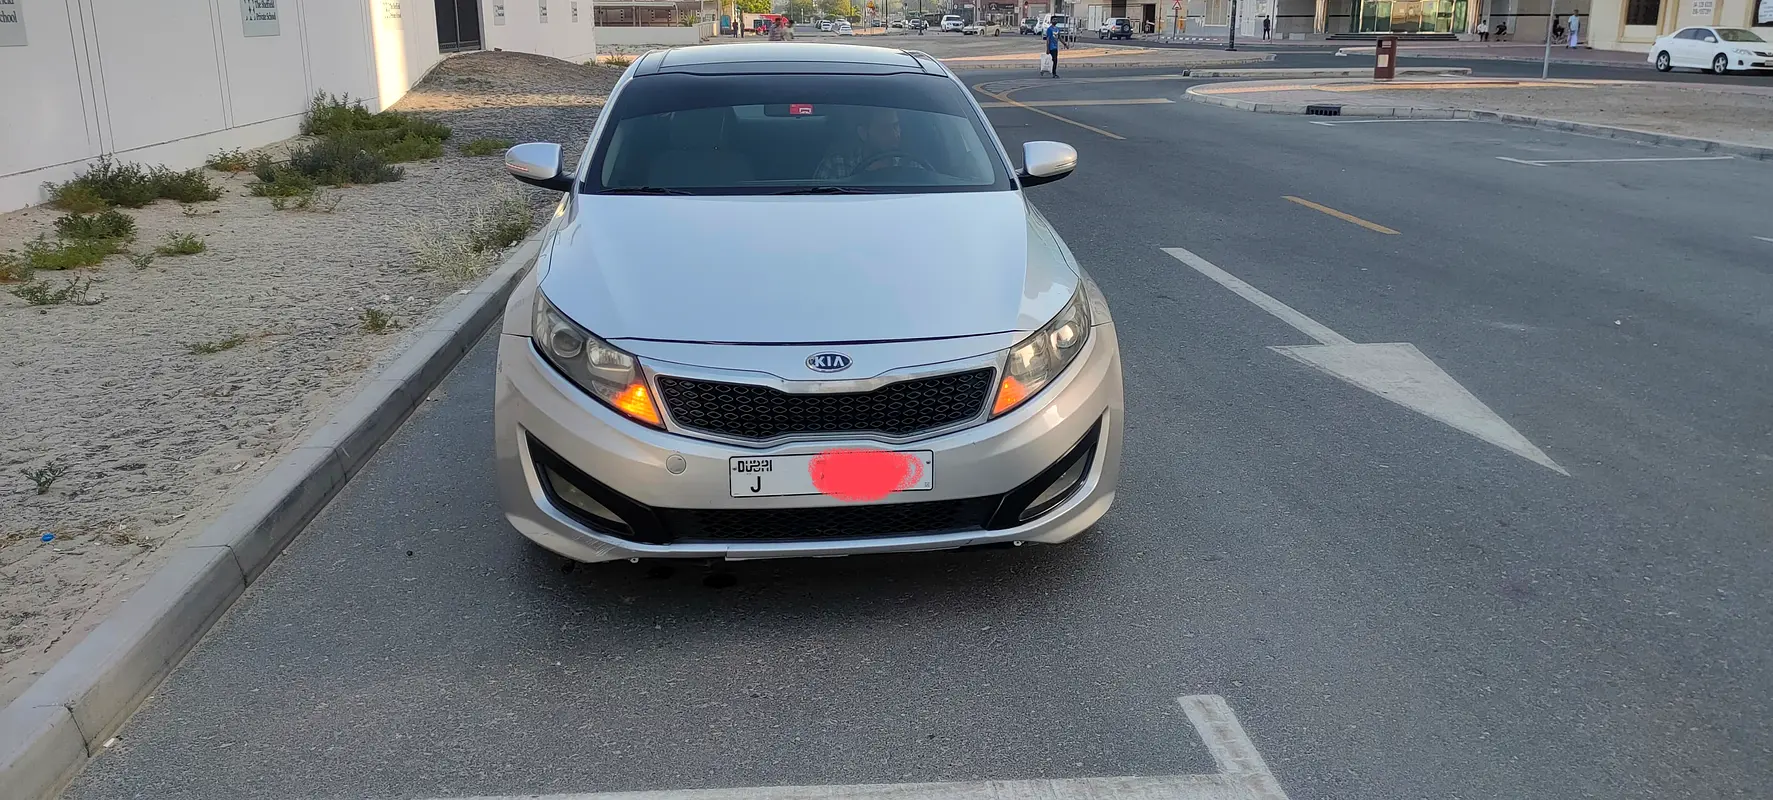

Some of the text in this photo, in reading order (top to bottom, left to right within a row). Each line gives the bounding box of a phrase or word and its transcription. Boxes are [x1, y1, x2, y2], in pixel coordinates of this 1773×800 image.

[815, 356, 845, 367] KIA
[737, 459, 773, 472] DUBAI
[750, 475, 761, 493] J
